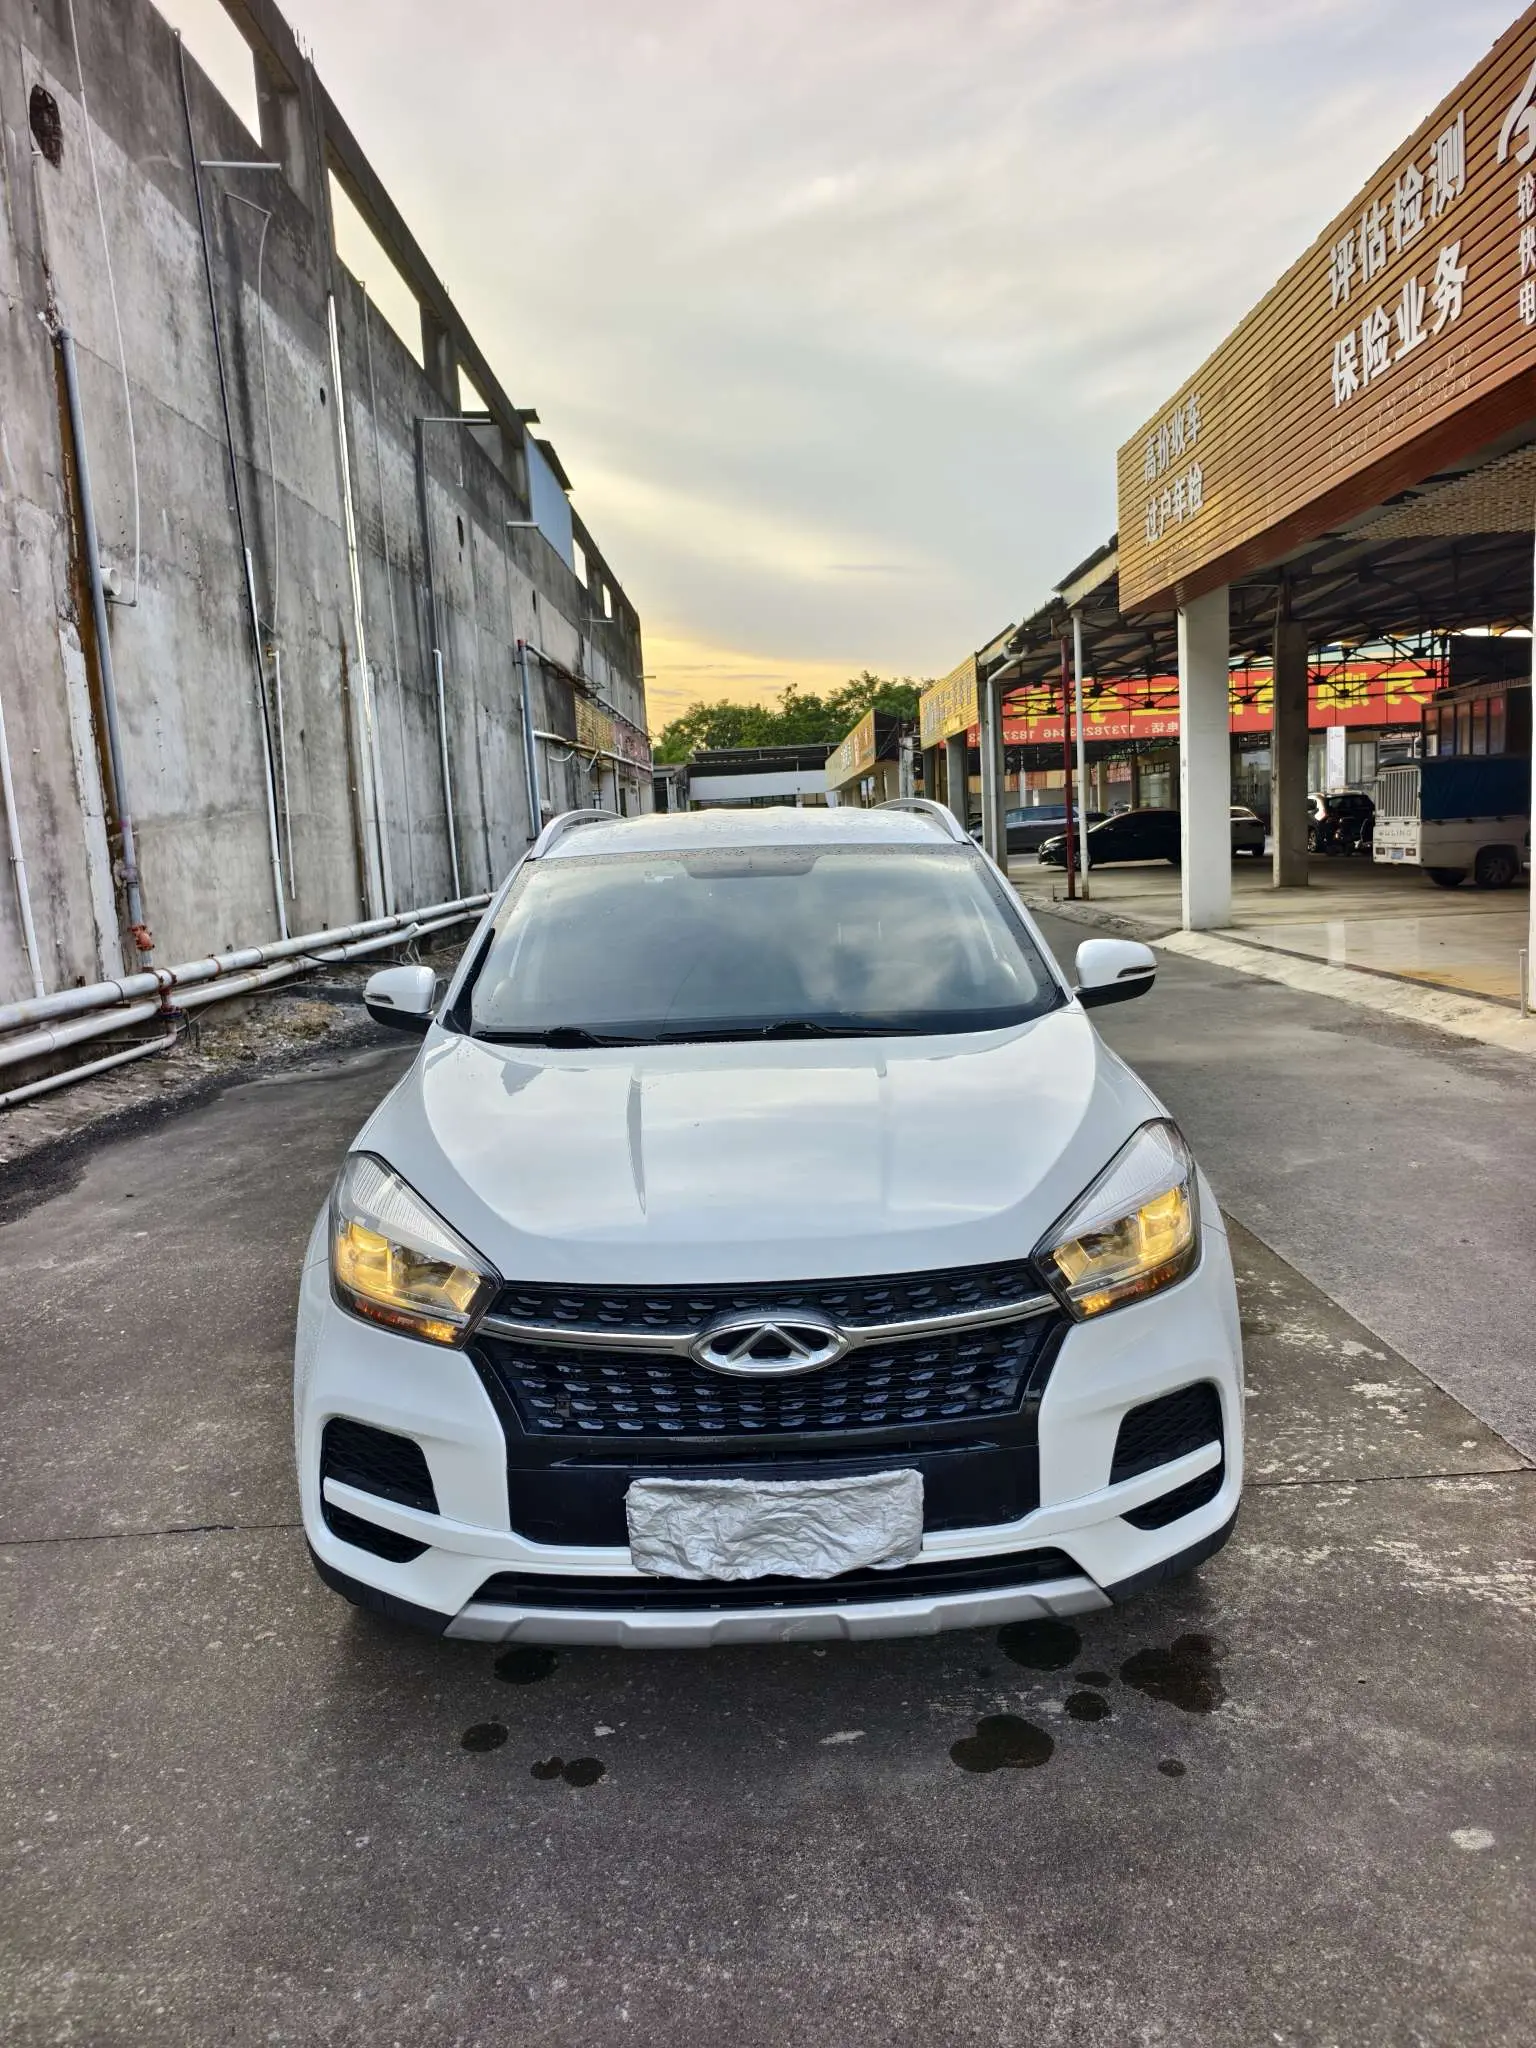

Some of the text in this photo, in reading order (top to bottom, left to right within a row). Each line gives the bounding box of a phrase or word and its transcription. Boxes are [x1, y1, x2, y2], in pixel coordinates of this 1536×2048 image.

[1329, 109, 1467, 310] 评估检测
[1331, 239, 1468, 408] 保险业务
[1144, 392, 1202, 485] 高价收车
[1145, 461, 1204, 547] 过户年检
